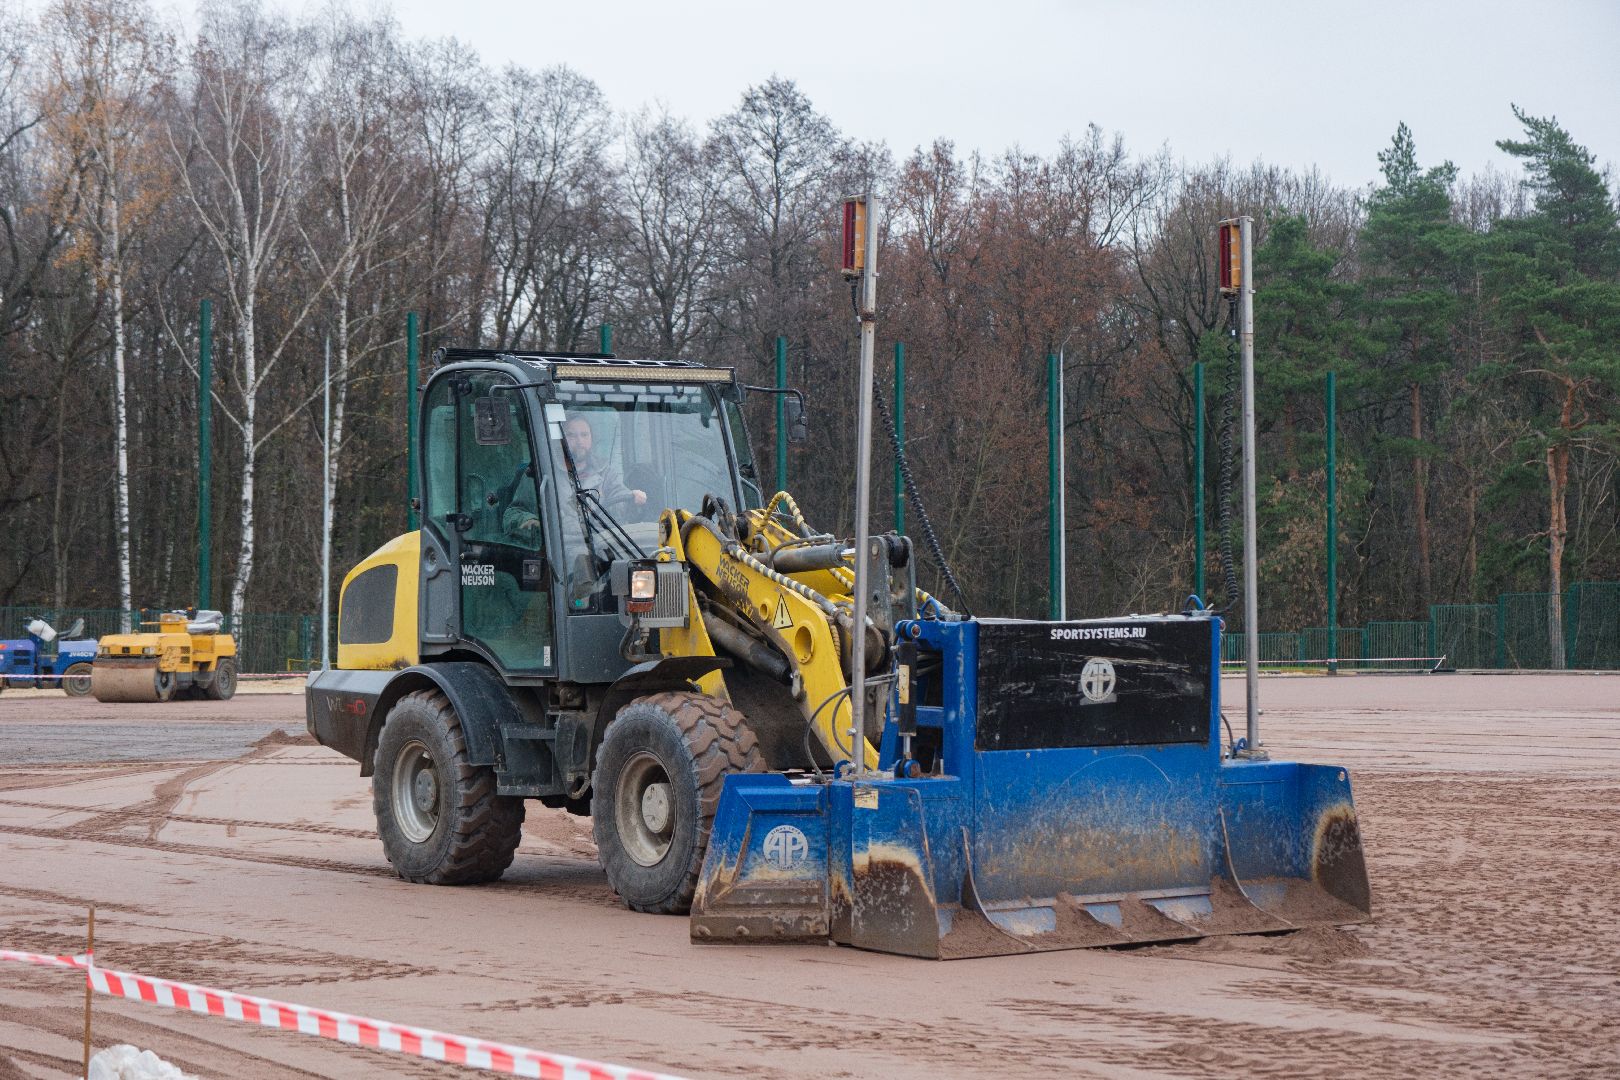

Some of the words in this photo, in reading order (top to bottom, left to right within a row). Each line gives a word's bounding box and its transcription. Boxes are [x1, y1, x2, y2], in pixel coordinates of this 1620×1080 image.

[461, 564, 495, 575] WACKER
[461, 575, 495, 586] NEUSON
[1050, 627, 1147, 639] SPORTSYSTEMS.RU
